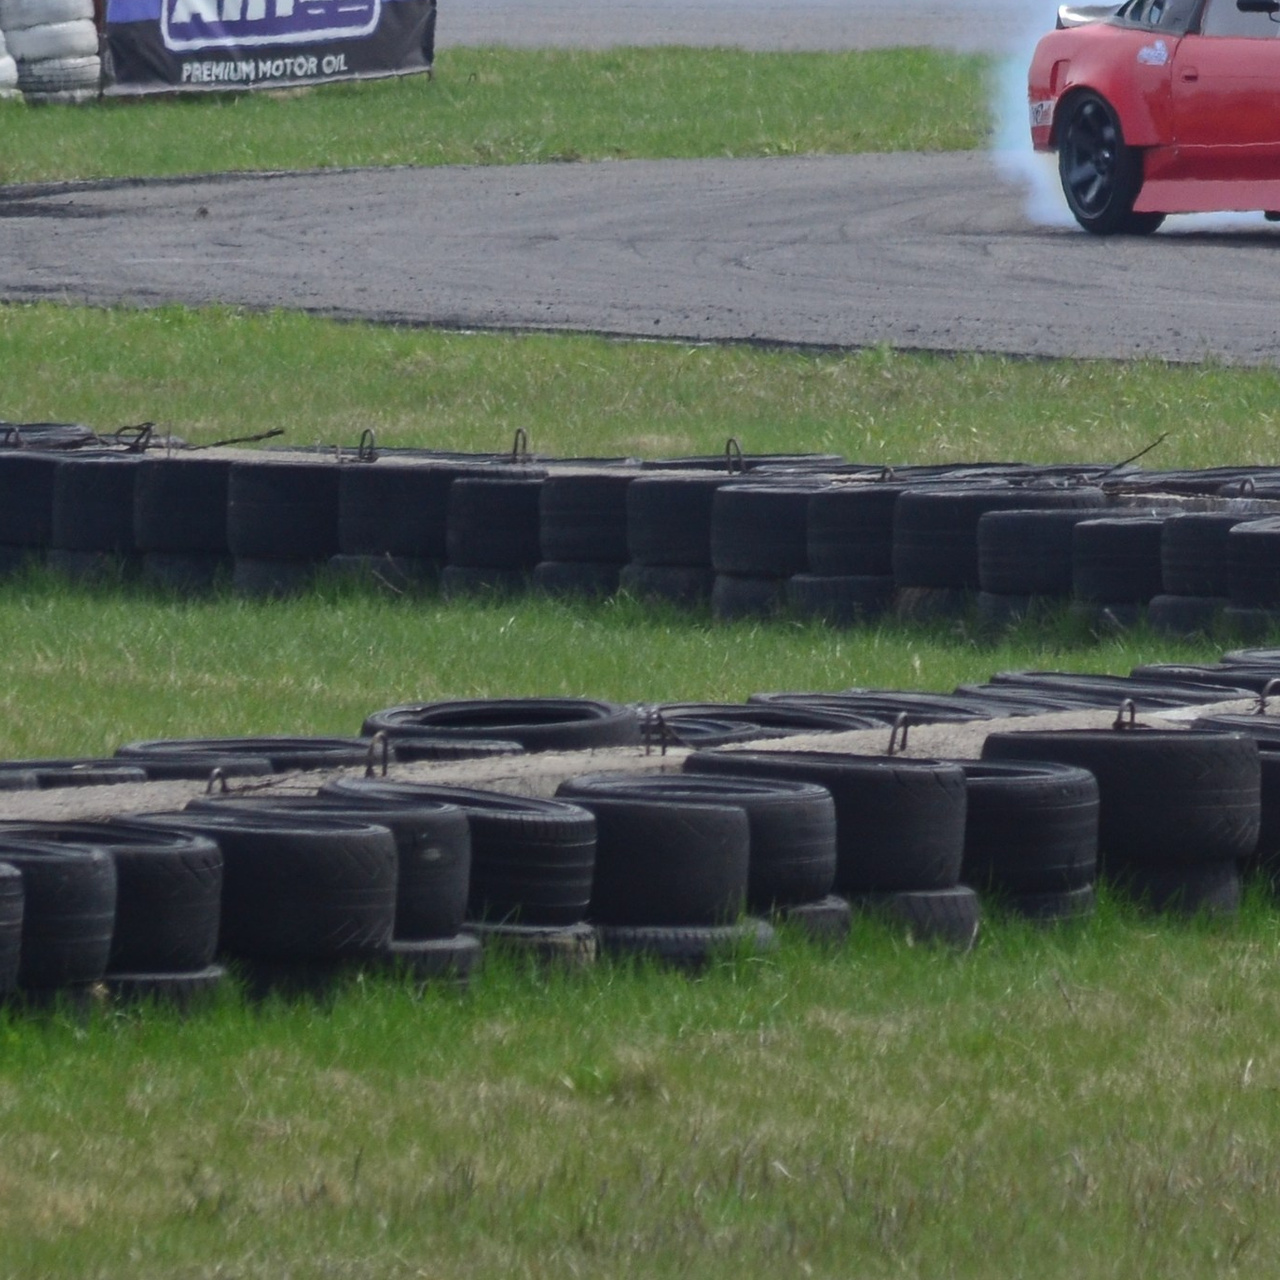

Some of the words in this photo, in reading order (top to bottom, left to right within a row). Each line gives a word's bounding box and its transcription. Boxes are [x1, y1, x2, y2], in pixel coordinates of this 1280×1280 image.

[182, 61, 256, 82] PREMIUM
[258, 54, 318, 78] MOTOR
[322, 53, 348, 74] OIL
